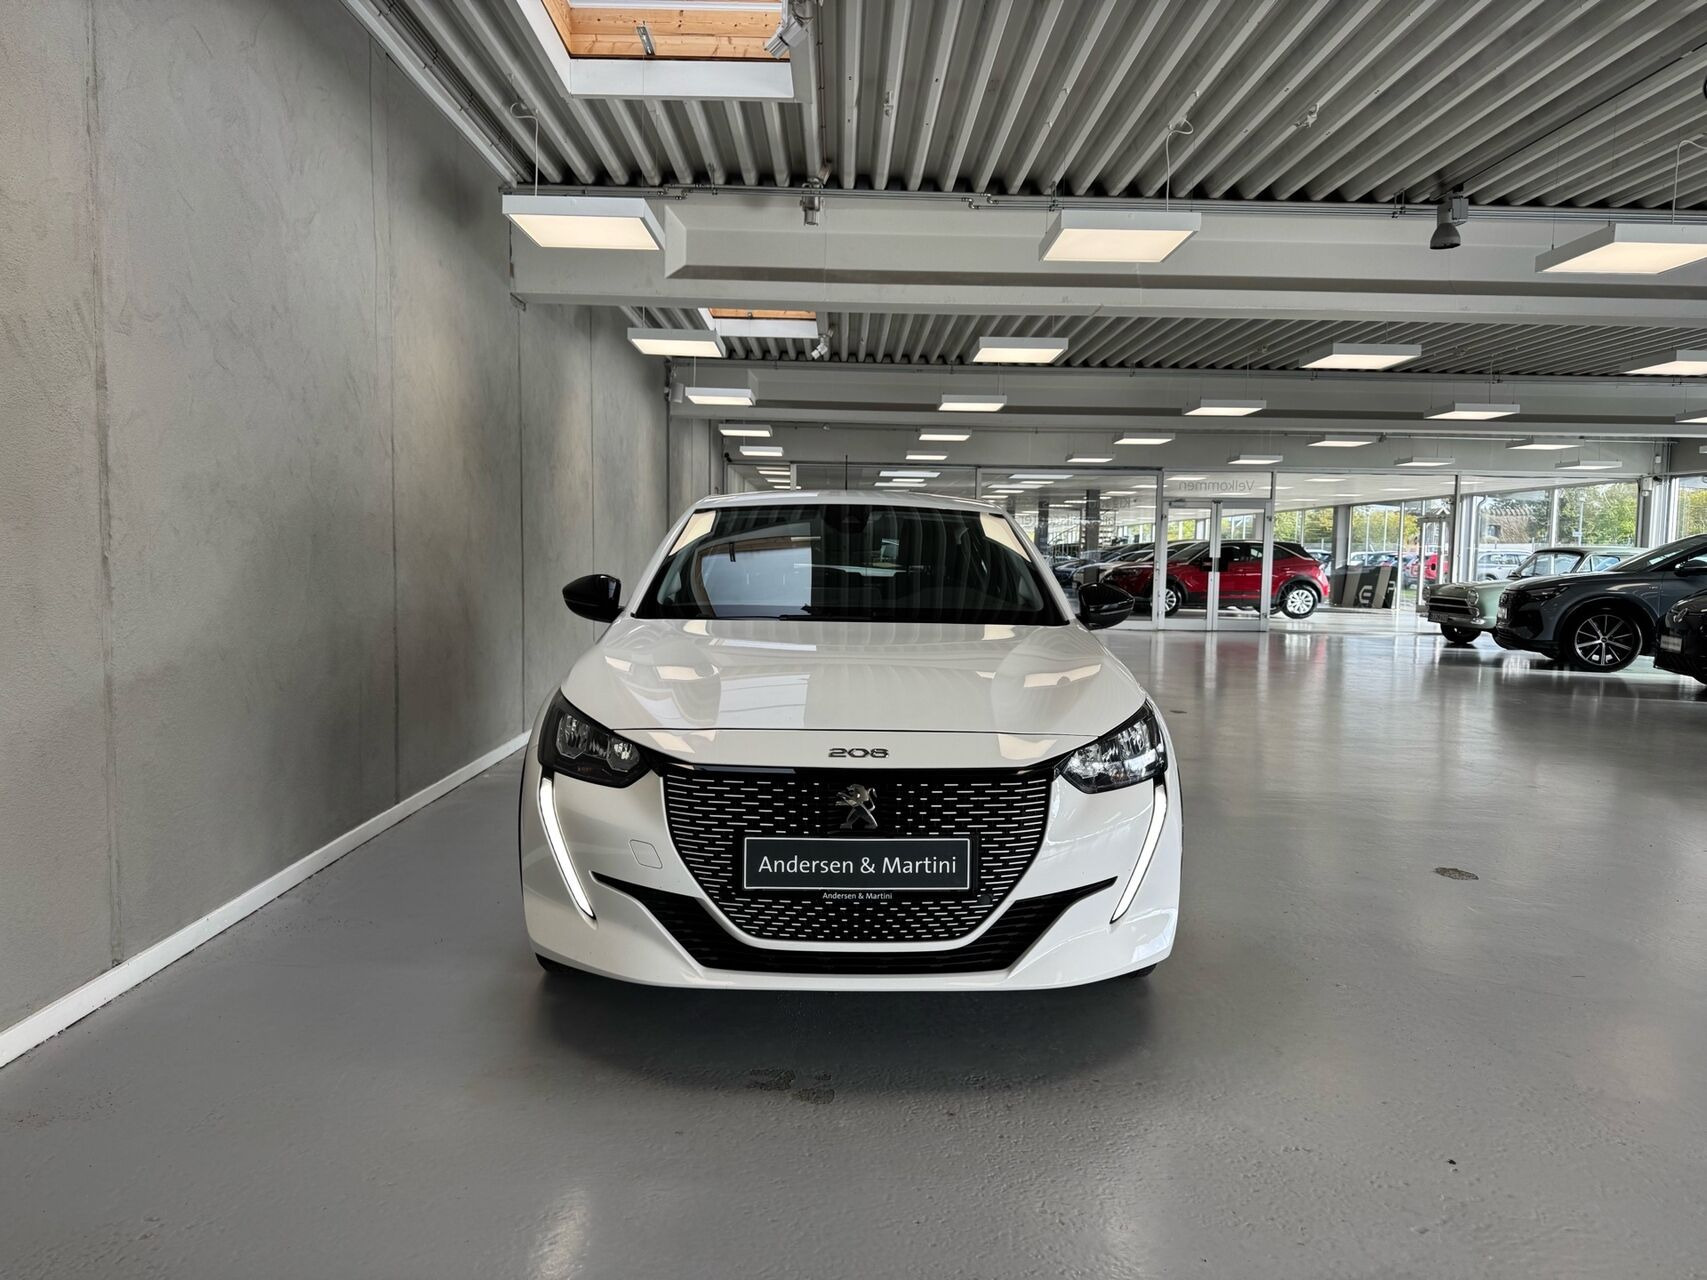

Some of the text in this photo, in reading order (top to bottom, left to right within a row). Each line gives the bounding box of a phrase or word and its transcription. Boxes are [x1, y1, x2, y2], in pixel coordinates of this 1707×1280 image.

[828, 748, 889, 758] 208
[758, 855, 957, 874] Andersen & Martini
[822, 892, 857, 900] Andersen
[866, 892, 893, 900] Martini
